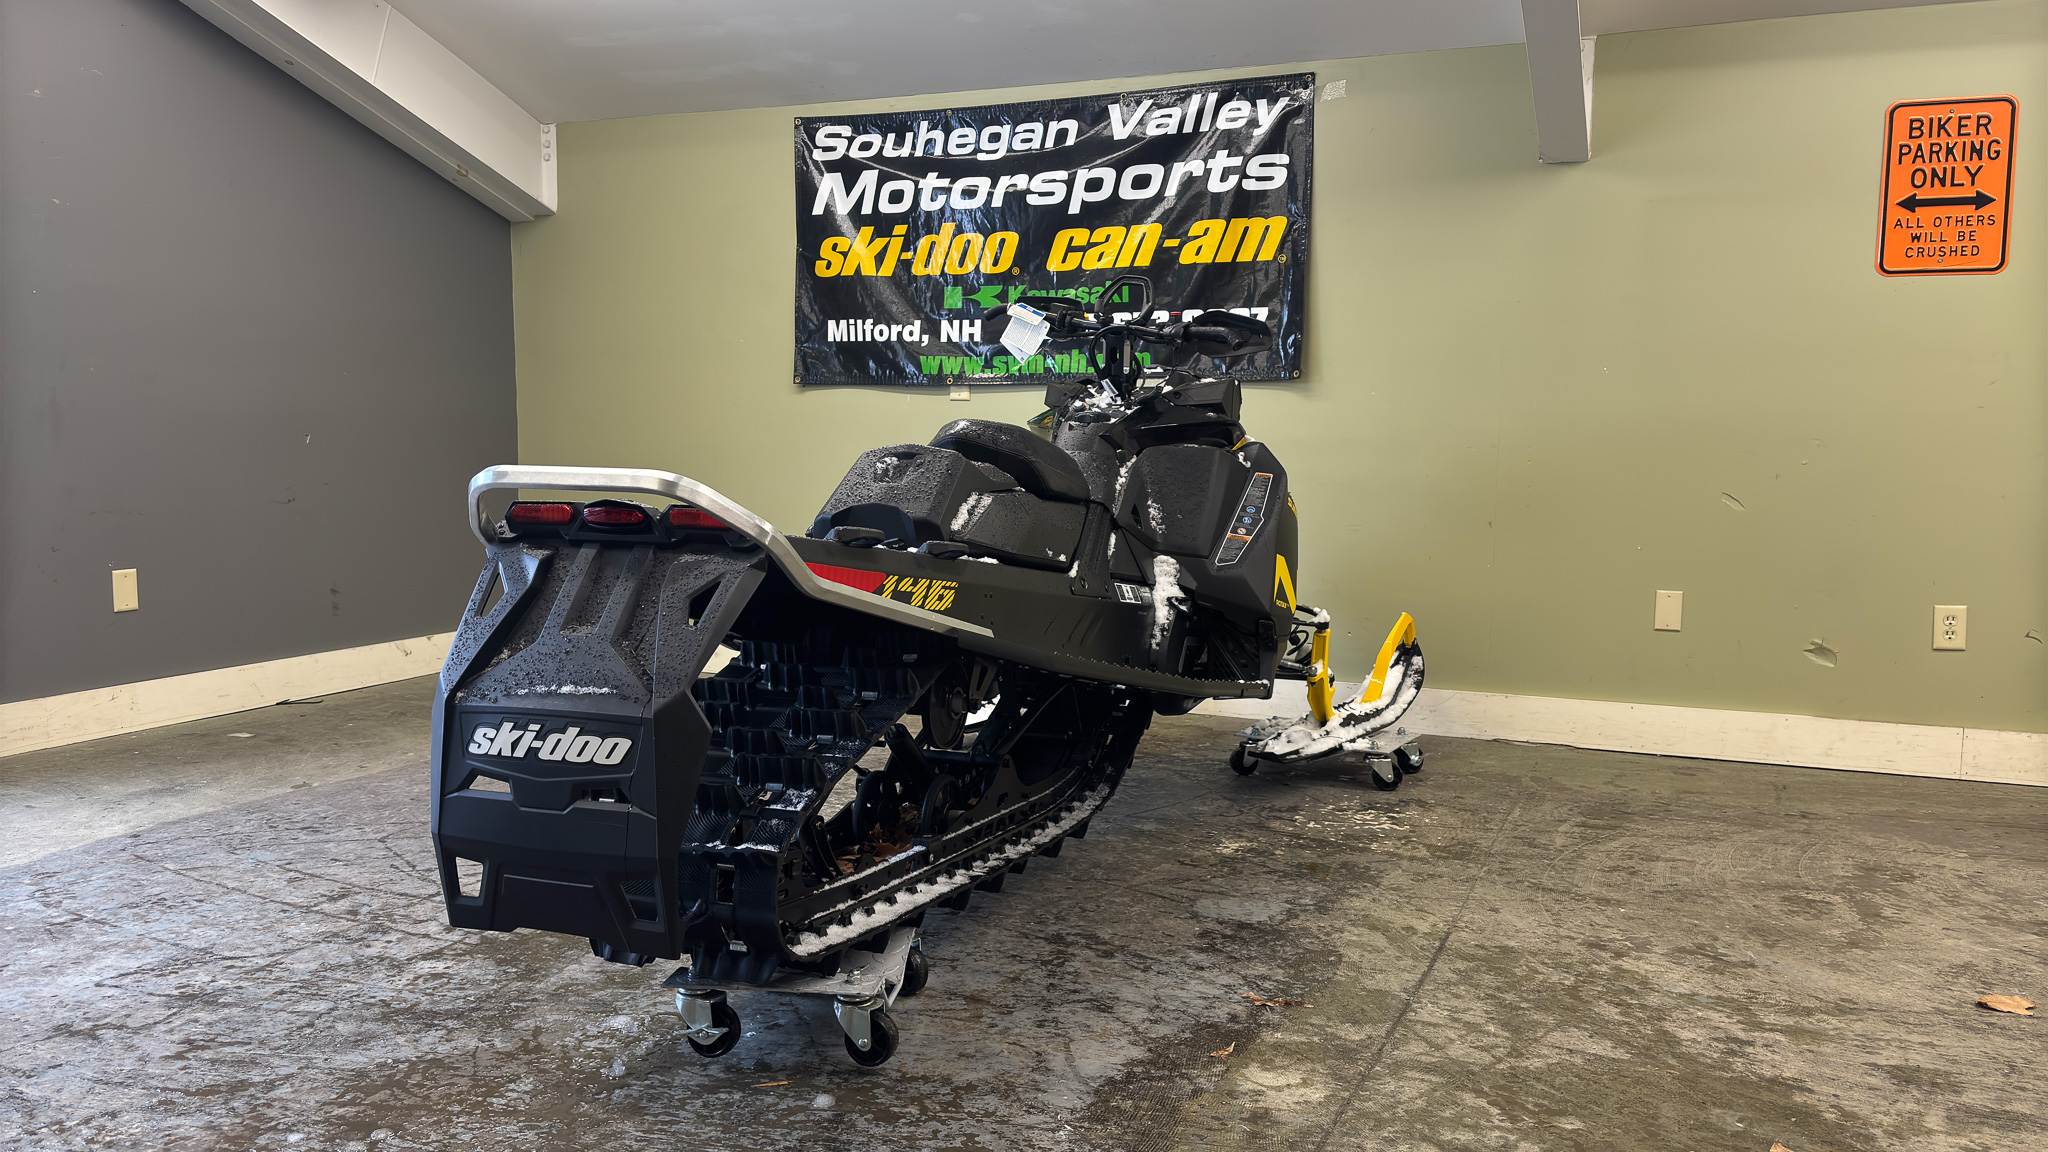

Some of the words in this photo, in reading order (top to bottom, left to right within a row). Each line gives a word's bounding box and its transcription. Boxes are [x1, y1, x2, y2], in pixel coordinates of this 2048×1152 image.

[812, 119, 1079, 161] Souhegan
[1107, 92, 1291, 141] Valley
[1908, 114, 1993, 139] BIKER
[1897, 139, 2002, 165] PARKING
[811, 150, 1290, 216] Motorsports
[1910, 164, 1984, 188] ONLY
[1893, 217, 1925, 229] ALL
[1933, 215, 1996, 228] OTHERS
[814, 222, 1020, 278] ski-doo
[1046, 215, 1288, 272] can-am
[1910, 231, 1948, 243] WILL
[1957, 230, 1977, 242] BE
[1905, 245, 1980, 258] CRUSHED
[827, 319, 930, 347] Milford,
[940, 319, 982, 343] NH
[920, 348, 1151, 376] www.svm-nh.m
[468, 721, 633, 765] ski-doo
